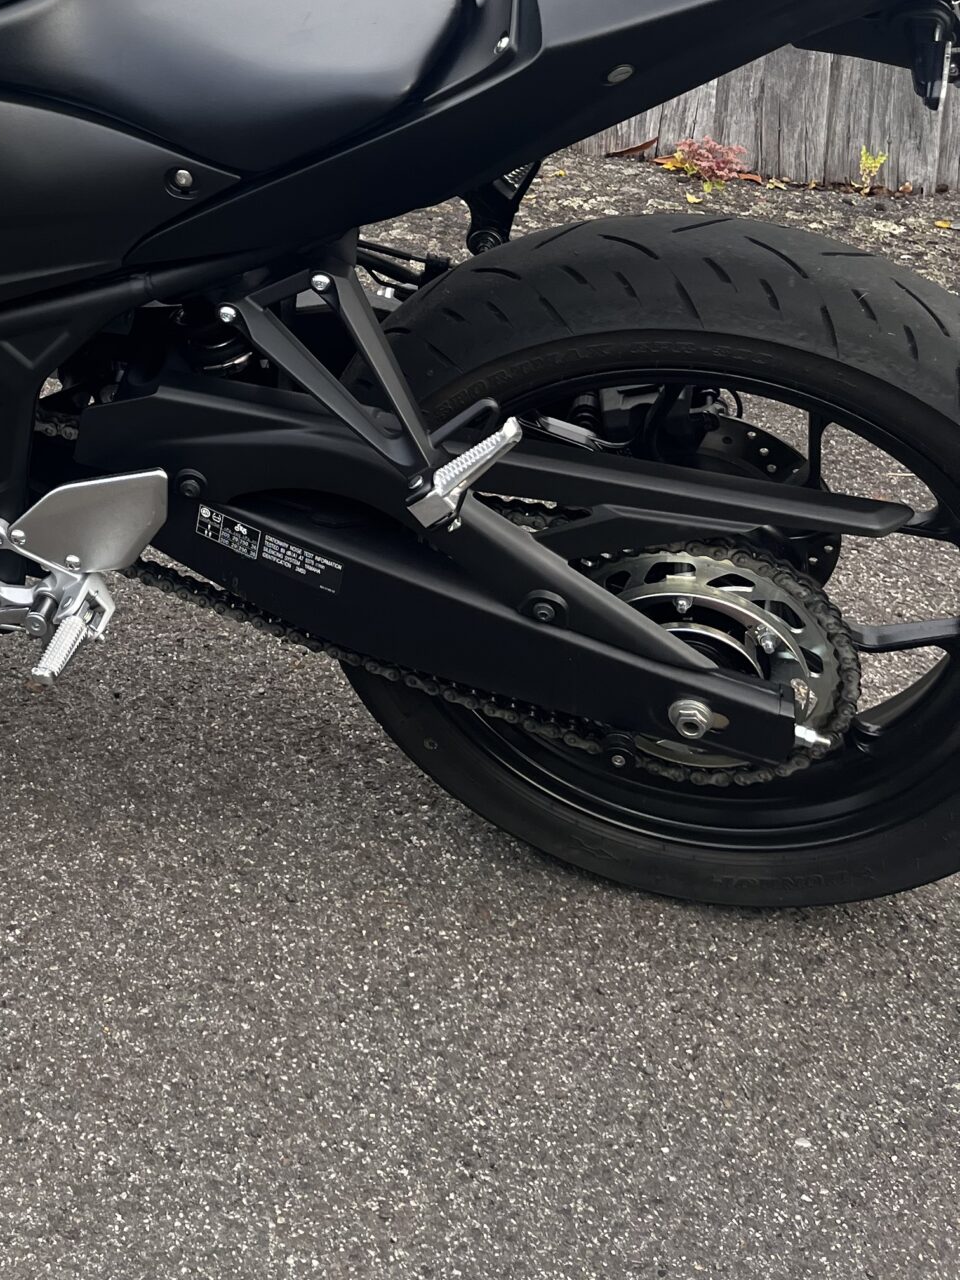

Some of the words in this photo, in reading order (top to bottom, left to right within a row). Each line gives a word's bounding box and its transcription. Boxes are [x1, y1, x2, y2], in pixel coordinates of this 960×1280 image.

[289, 545, 302, 554] NOISE
[314, 556, 342, 570] INFORMATION
[304, 564, 321, 574] YAMAHA
